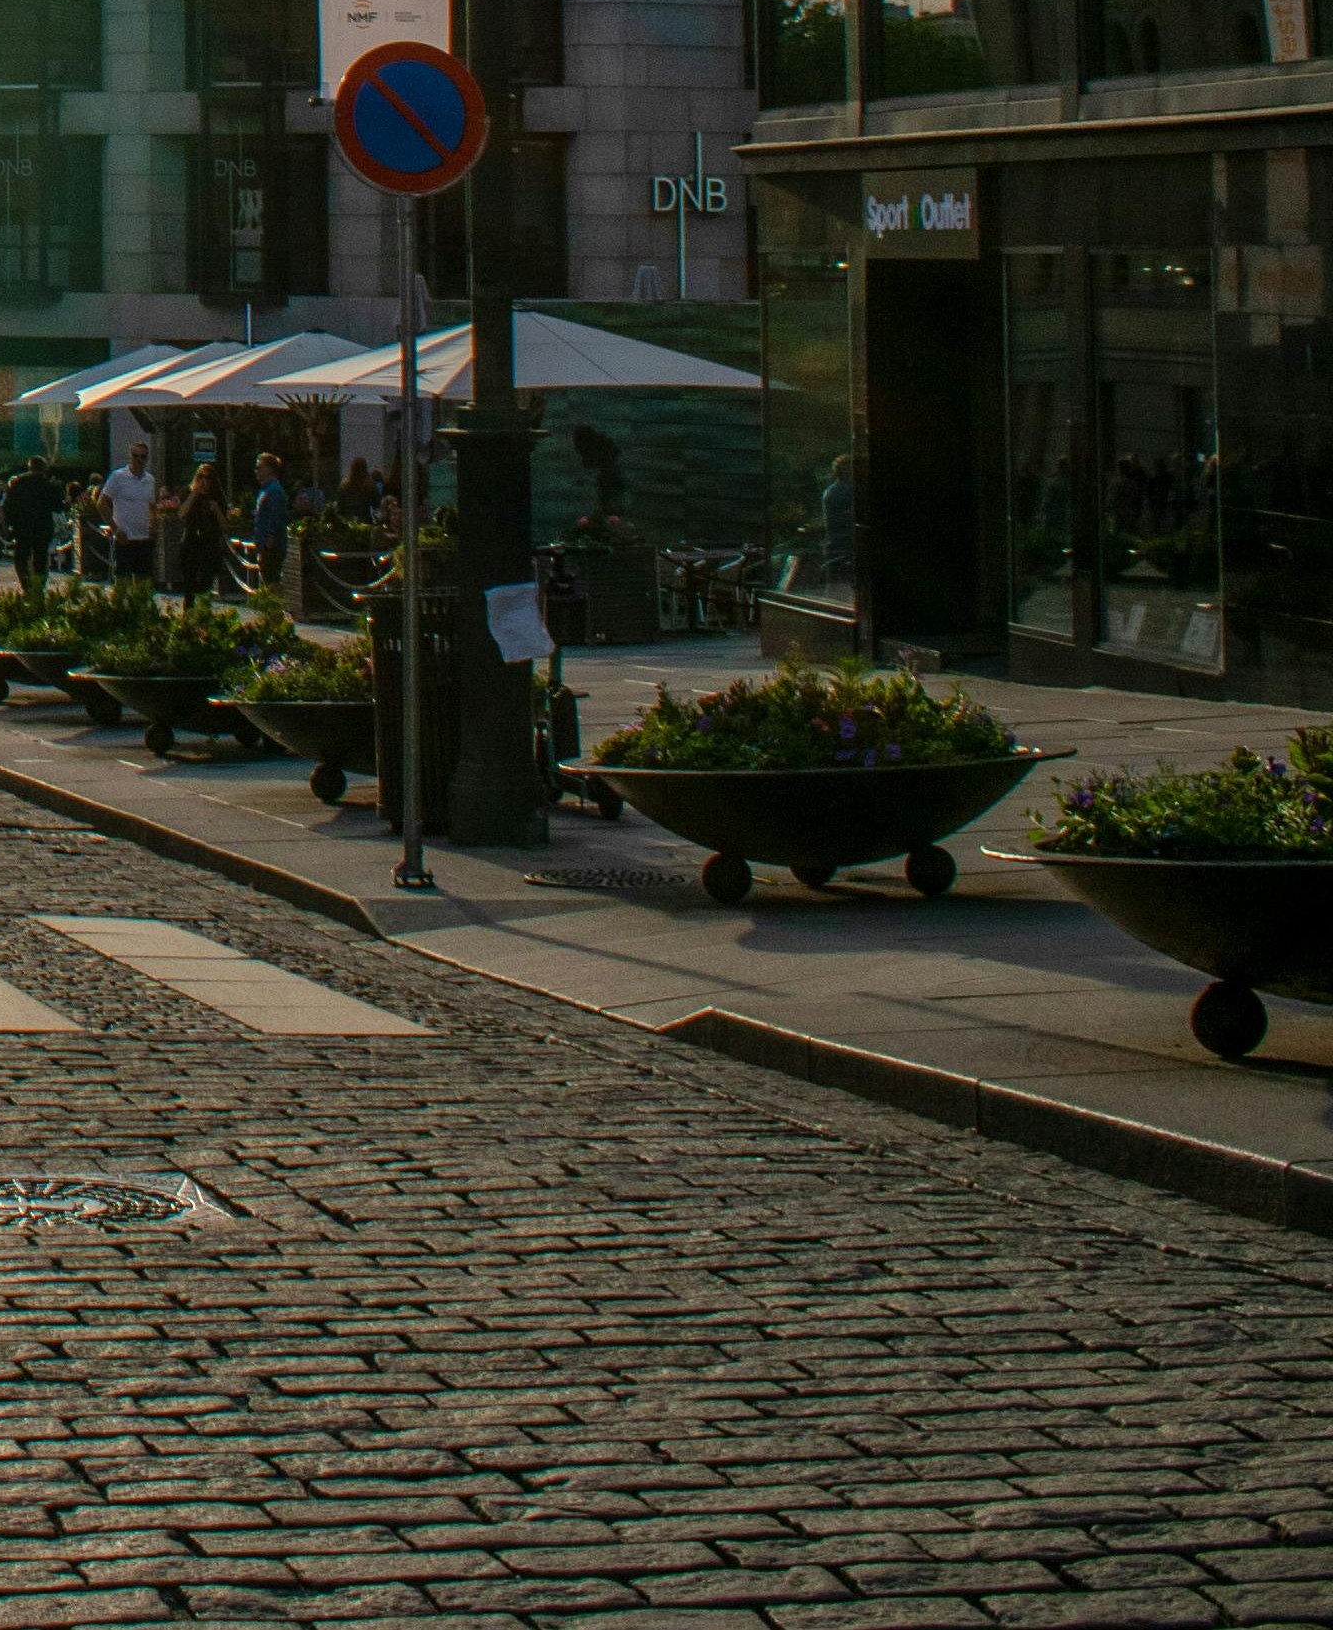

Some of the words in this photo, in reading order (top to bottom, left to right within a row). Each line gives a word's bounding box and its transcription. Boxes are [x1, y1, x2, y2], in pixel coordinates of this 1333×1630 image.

[346, 11, 378, 23] NMF
[214, 158, 257, 177] DNB
[652, 176, 728, 213] DNB
[867, 193, 910, 239] Sport
[920, 192, 971, 231] Outlet
